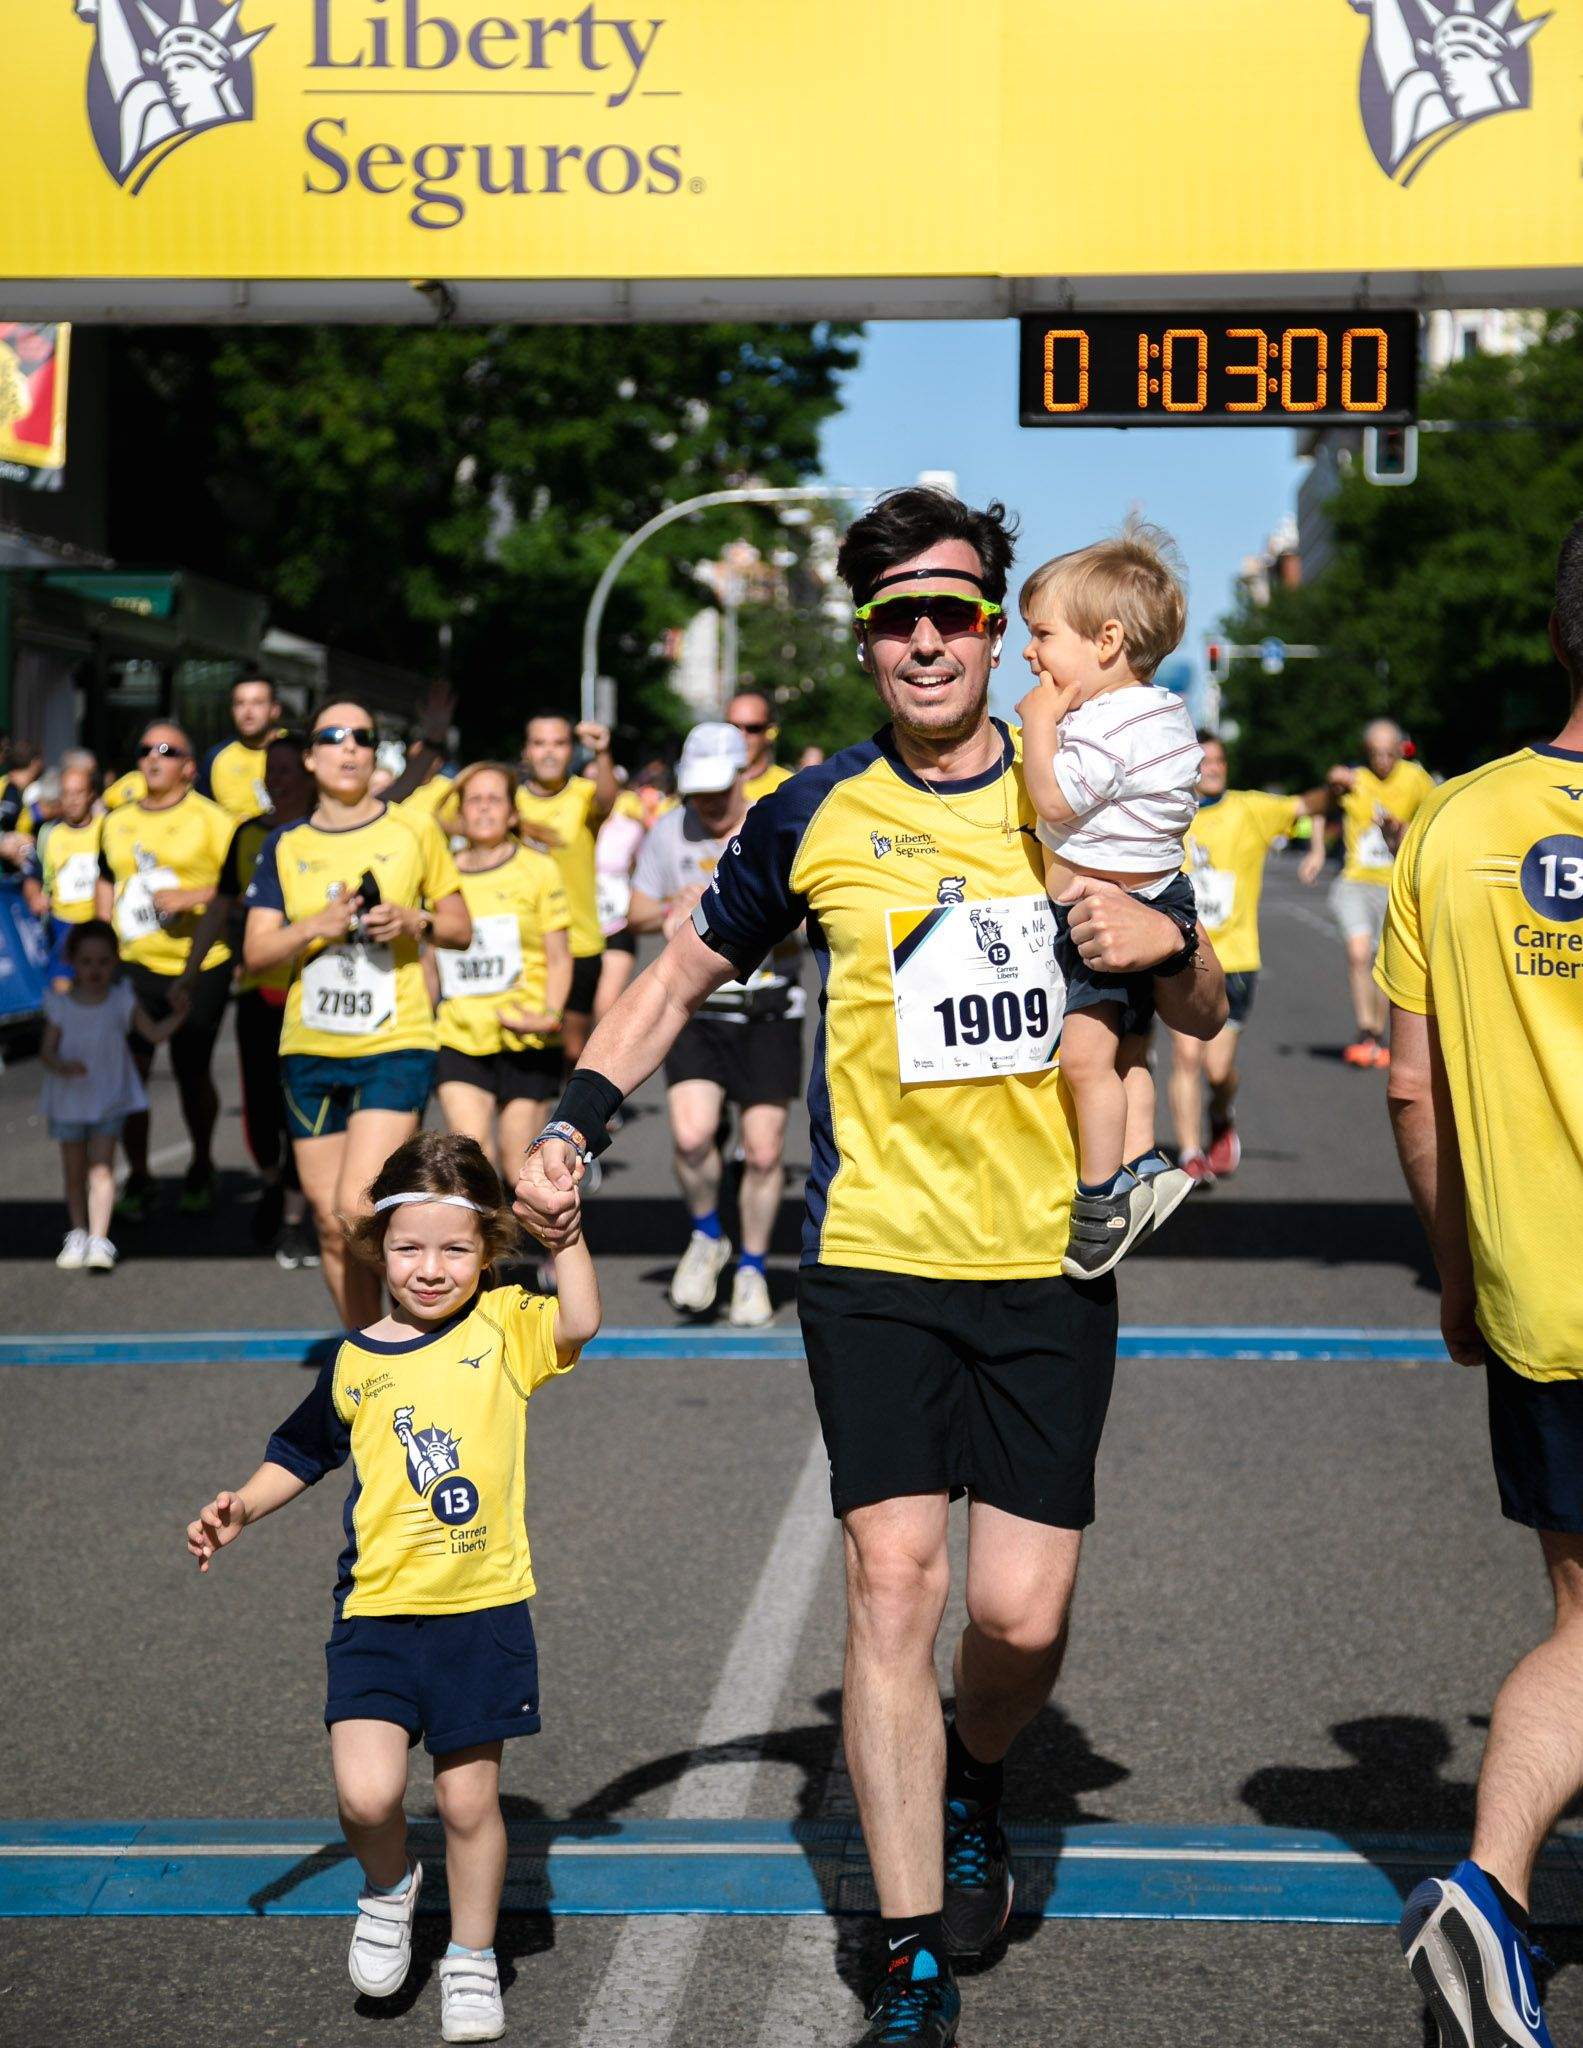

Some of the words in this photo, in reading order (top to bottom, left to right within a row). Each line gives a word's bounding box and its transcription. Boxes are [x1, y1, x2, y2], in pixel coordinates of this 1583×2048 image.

[304, 0, 665, 107] Liberty
[894, 833, 932, 845] Liberty
[1538, 854, 1583, 901] 13
[991, 947, 1008, 961] 13
[996, 965, 1019, 974] Carrera
[1515, 952, 1583, 979] Liber
[997, 972, 1019, 980] Liberty
[316, 986, 373, 1017] 2793
[933, 987, 1050, 1048] 1909
[361, 1372, 391, 1390] Liberty
[440, 1487, 470, 1515] 13
[450, 1526, 487, 1540] Carrera
[451, 1539, 487, 1554] Liberty
